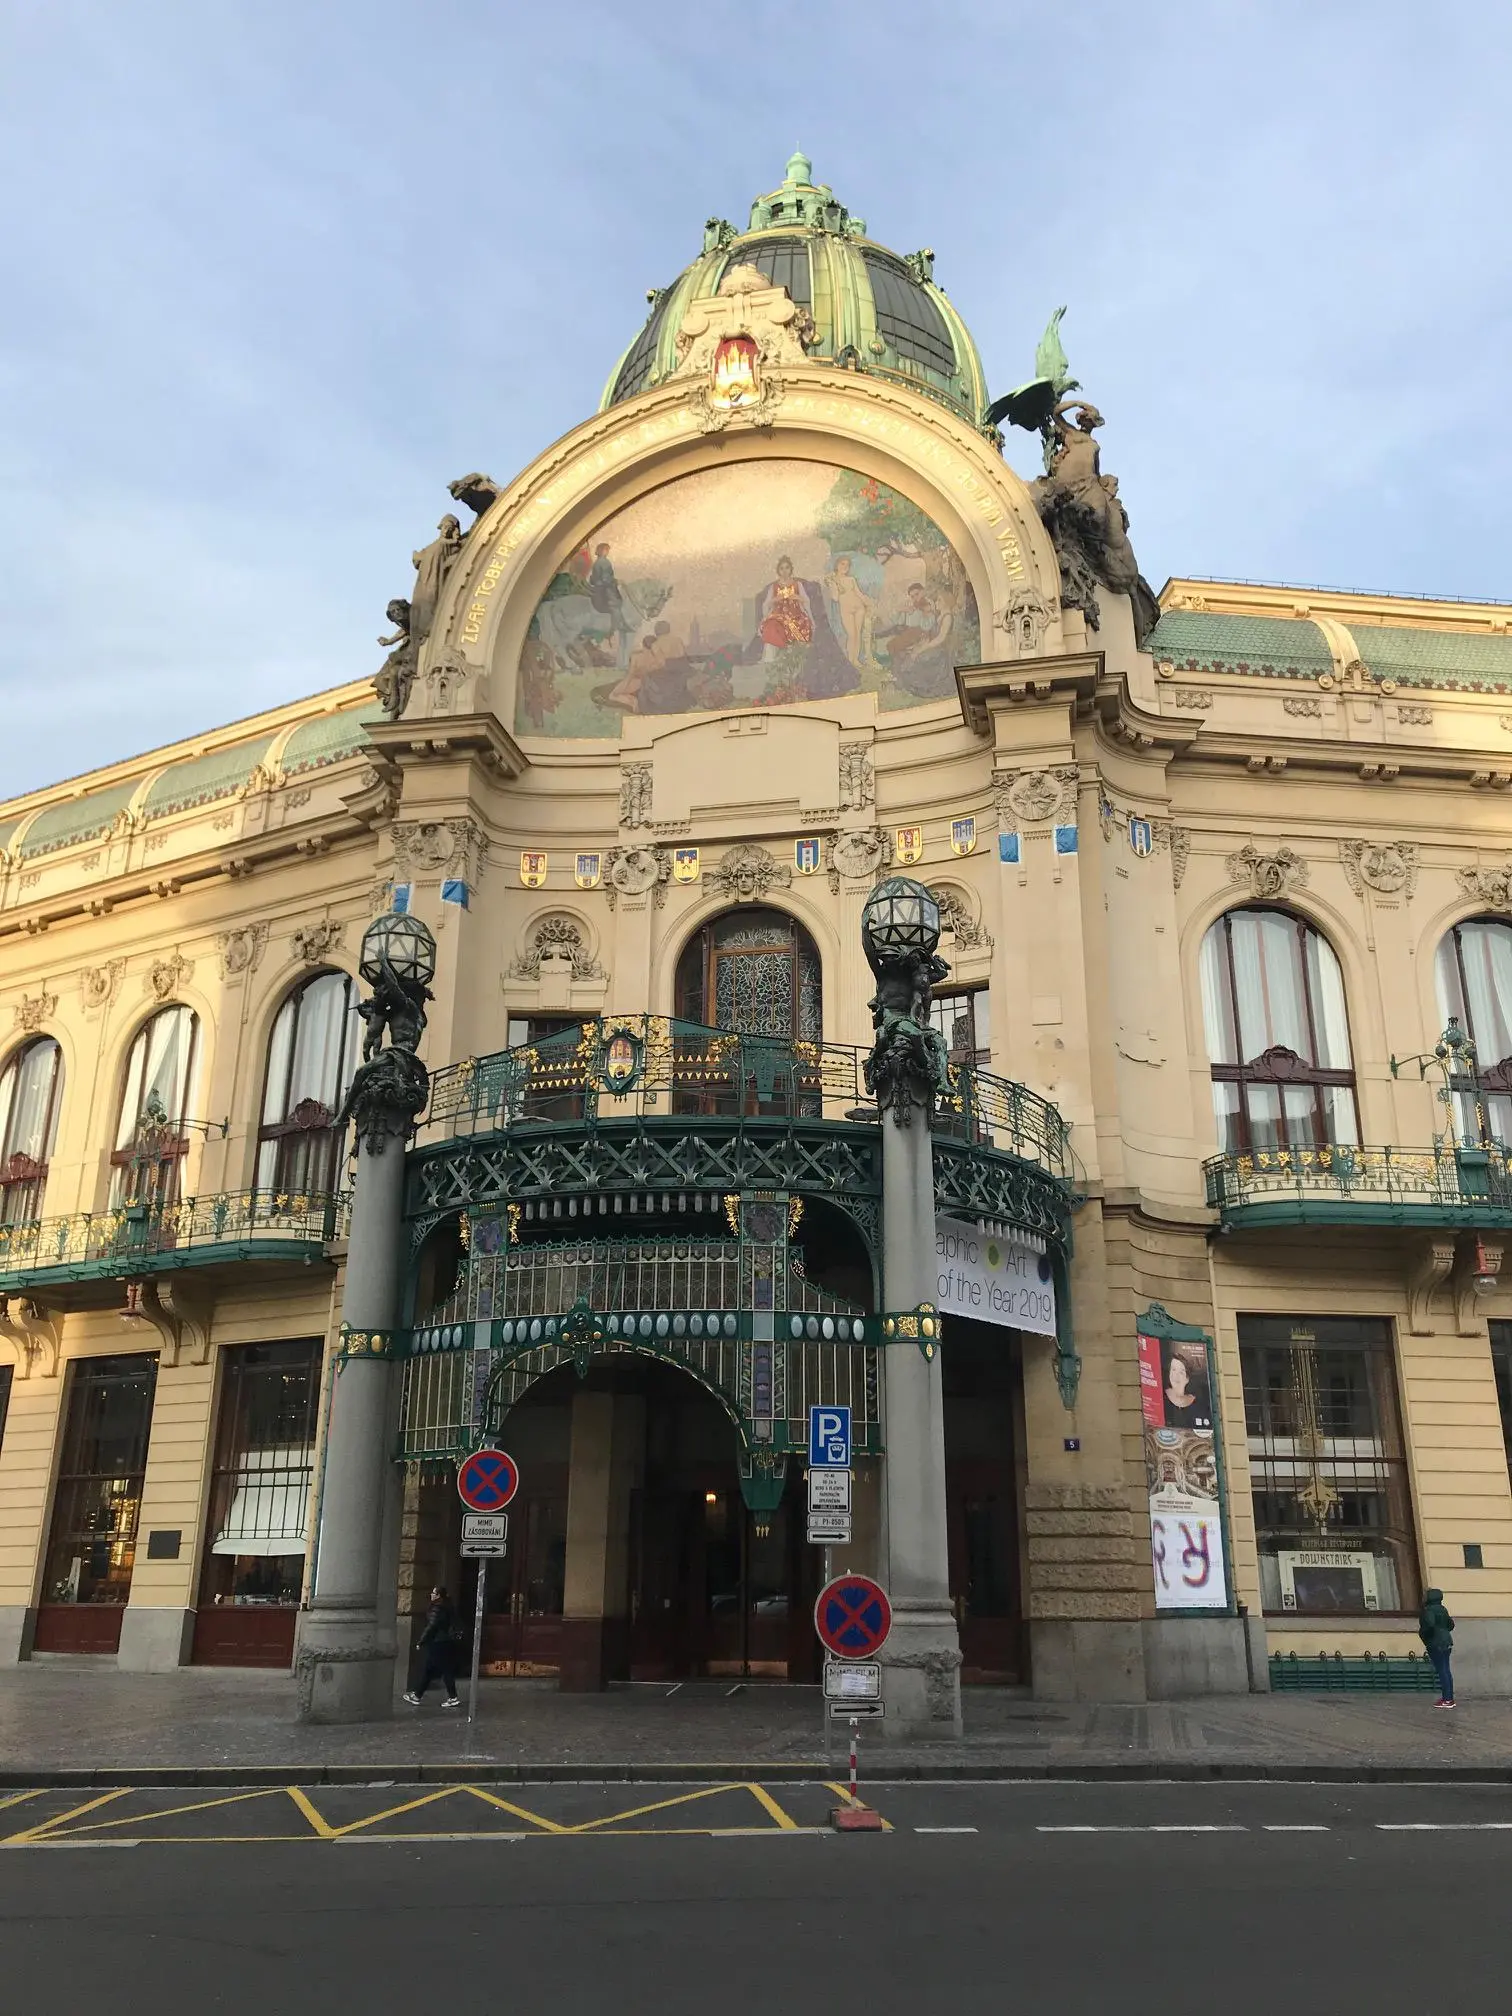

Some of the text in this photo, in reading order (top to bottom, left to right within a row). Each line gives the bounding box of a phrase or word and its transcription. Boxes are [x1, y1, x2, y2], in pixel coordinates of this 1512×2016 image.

[461, 603, 486, 644] ZDAR
[1006, 1246, 1027, 1278] Art
[937, 1269, 1052, 1322] of the Year 2019
[818, 1413, 842, 1448] P
[1300, 1553, 1352, 1565] DOWNSTAIRS
